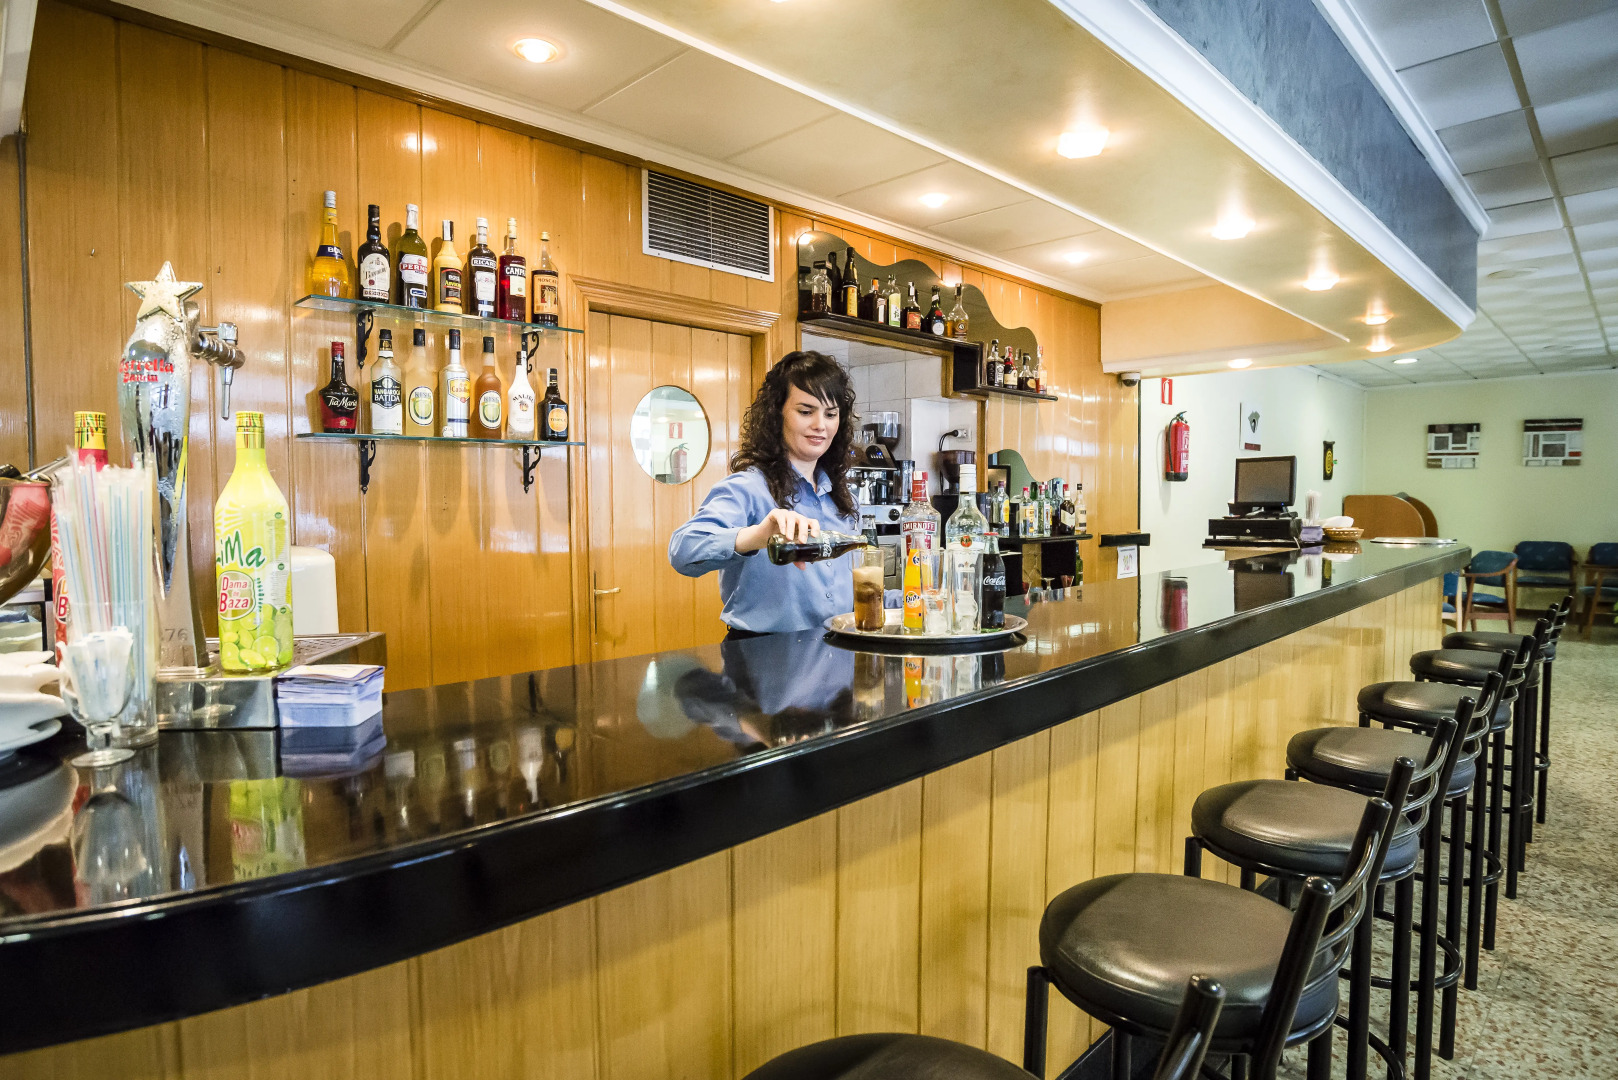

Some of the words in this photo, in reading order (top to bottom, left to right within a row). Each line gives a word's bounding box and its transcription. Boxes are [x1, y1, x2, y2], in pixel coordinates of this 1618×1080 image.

[326, 395, 340, 407] Tia
[374, 394, 401, 402] BATIDA
[903, 521, 936, 532] SMIRNOFF
[222, 576, 248, 591] Dama
[219, 592, 250, 612] Baza
